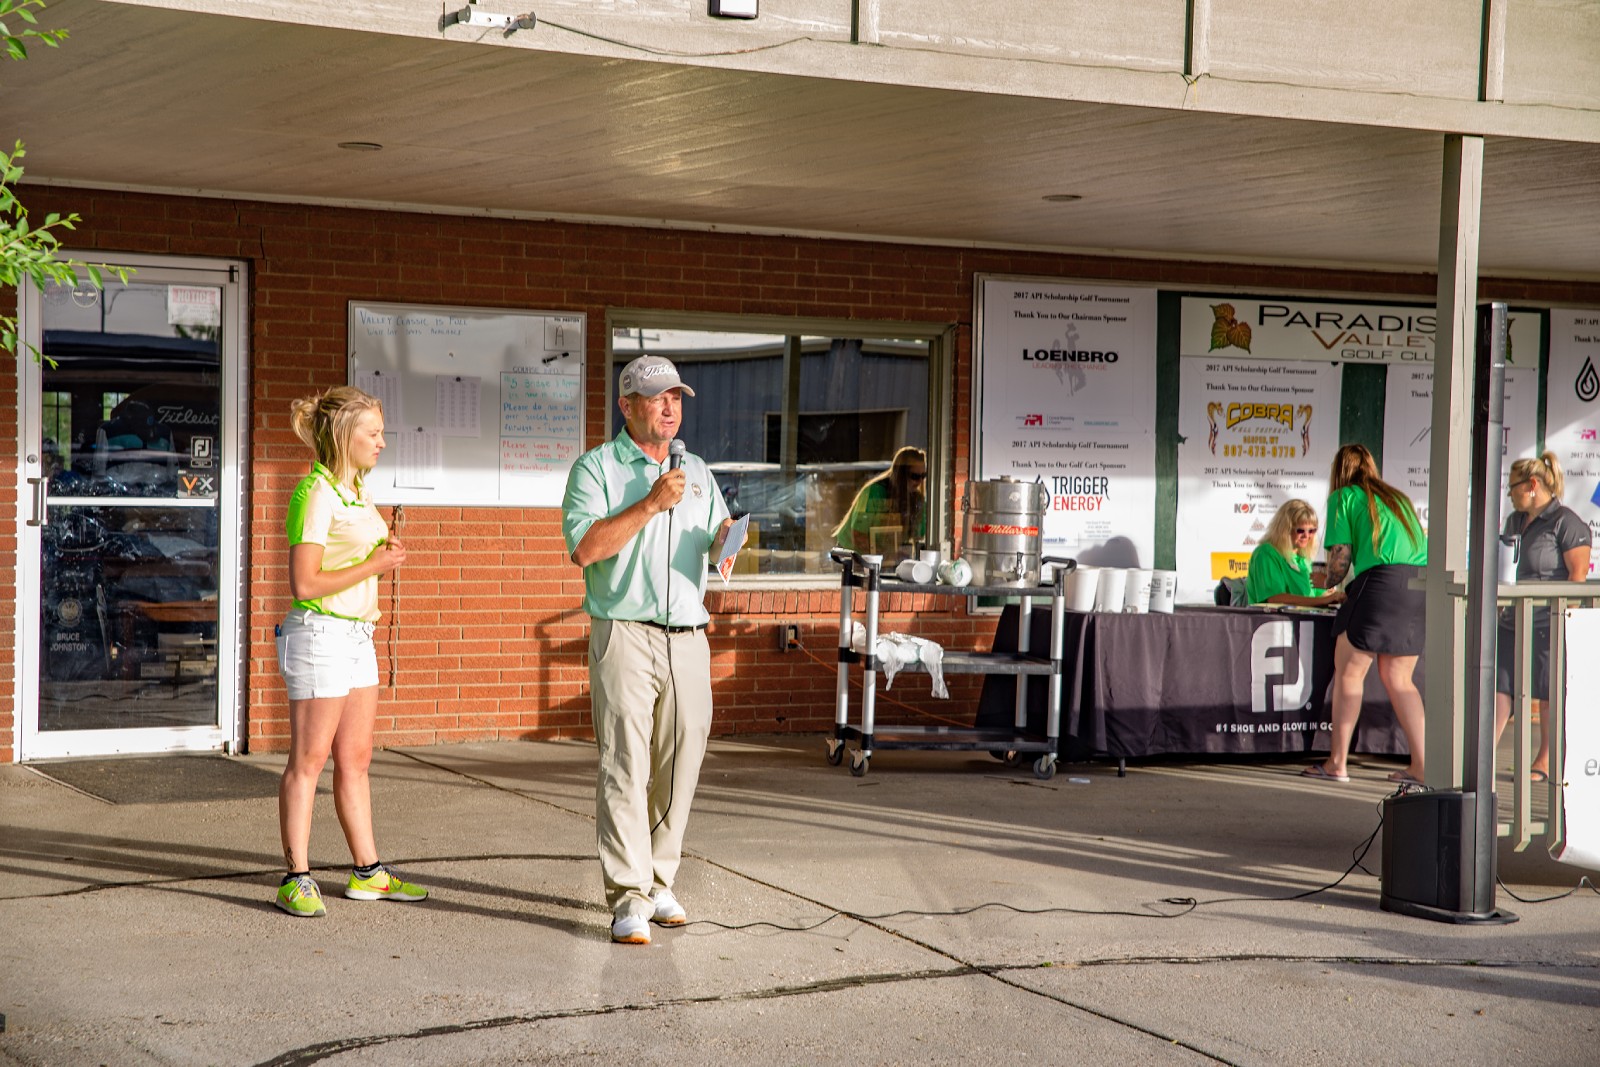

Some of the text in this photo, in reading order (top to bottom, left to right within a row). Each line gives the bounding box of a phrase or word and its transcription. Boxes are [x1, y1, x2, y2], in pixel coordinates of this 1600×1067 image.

[1030, 292, 1042, 300] API
[1044, 293, 1078, 303] Scholarship
[1014, 310, 1034, 318] Thank
[1037, 312, 1049, 320] You
[1058, 312, 1070, 320] Our
[1072, 313, 1102, 321] Chairman
[1103, 315, 1127, 323] Sponsor
[1259, 304, 1437, 334] PARADIS
[1023, 348, 1119, 363] LOENBRO
[1341, 349, 1434, 361] GOLF CLU
[1234, 366, 1267, 375] Scholarship
[1269, 366, 1281, 374] Golf
[1282, 367, 1316, 375] Tournament
[1248, 384, 1259, 392] Our
[1291, 386, 1314, 395] Sponsor
[1412, 390, 1429, 398] Thank
[158, 406, 220, 424] Titleist
[1226, 402, 1294, 432] COBRA
[194, 440, 210, 457] FJ
[1042, 442, 1077, 450] Scholarship
[1093, 442, 1128, 450] Tournament
[1100, 462, 1126, 470] Sponsors
[1233, 468, 1266, 478] Scholarship
[1052, 476, 1109, 498] TRIGGER
[1266, 482, 1292, 490] Beverage
[1054, 496, 1102, 511] ENERGY
[57, 632, 80, 640] BRUCE
[51, 643, 87, 651] JOHNSTON
[1251, 620, 1314, 712] FJ
[1216, 724, 1228, 732] #1
[1230, 724, 1255, 733] SHOE
[1258, 723, 1280, 732] AND
[1282, 722, 1307, 732] GLOVE
[1310, 722, 1318, 730] IN
